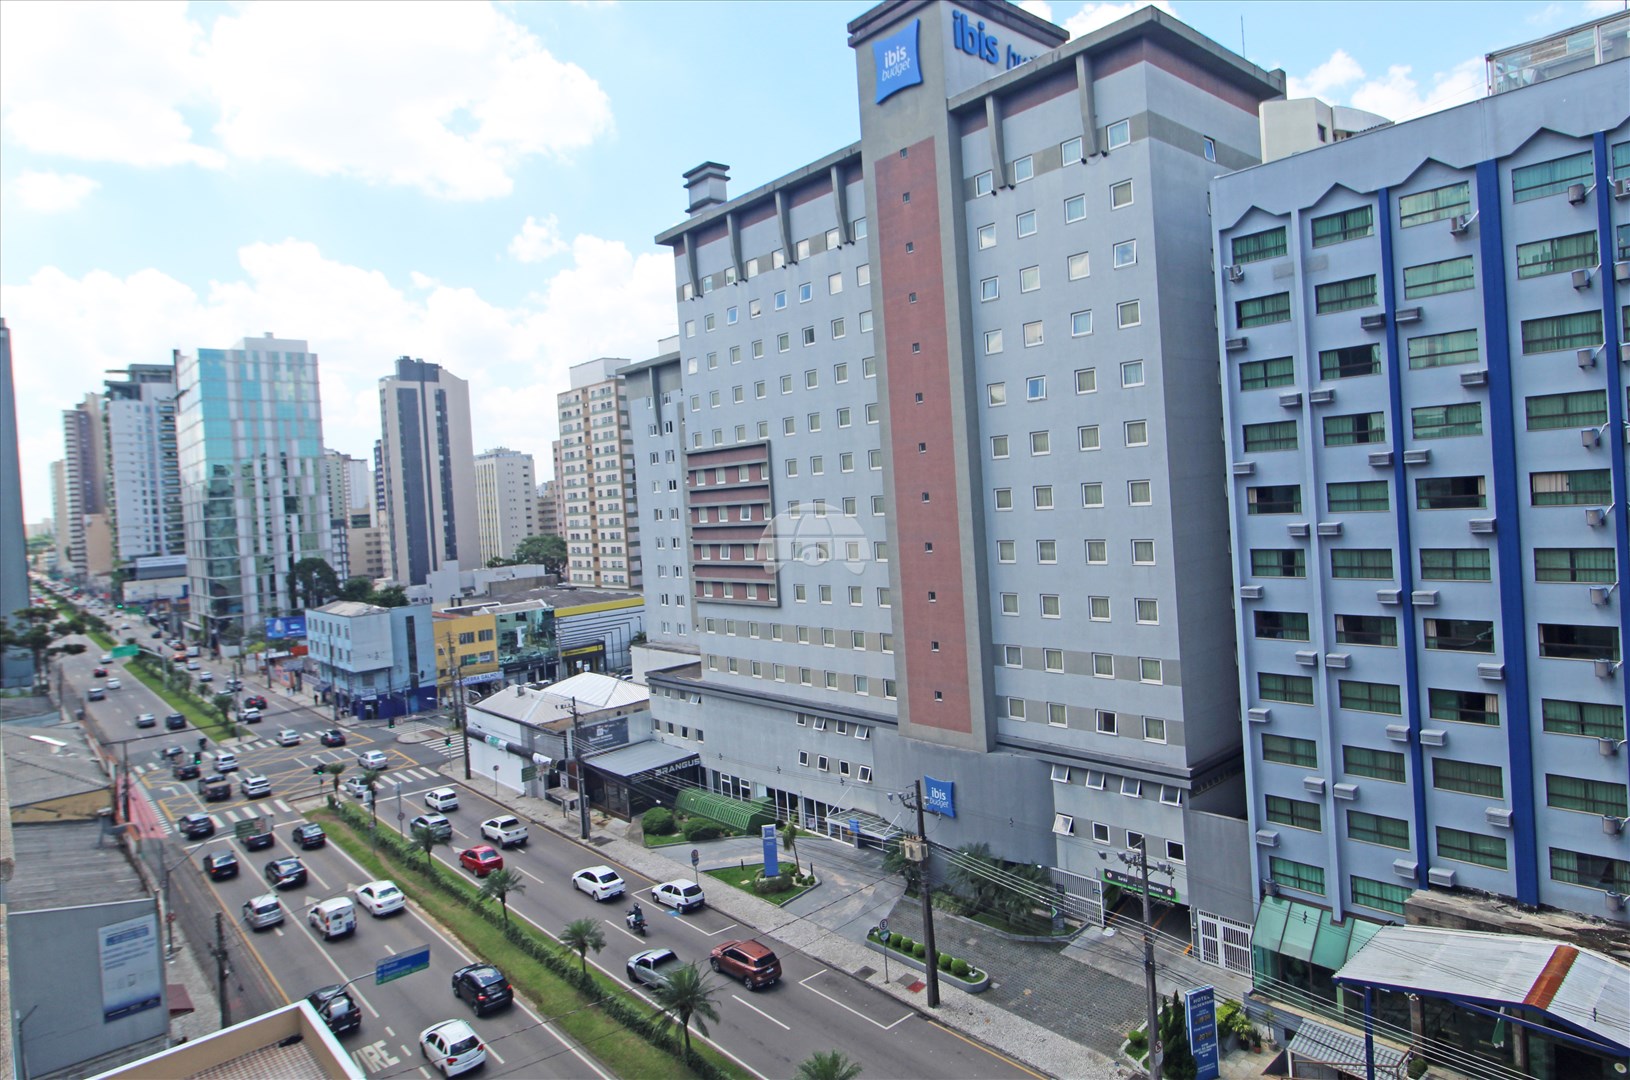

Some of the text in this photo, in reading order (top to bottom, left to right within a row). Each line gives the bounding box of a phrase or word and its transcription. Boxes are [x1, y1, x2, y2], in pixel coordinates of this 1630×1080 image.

[952, 9, 999, 65] ibis
[884, 45, 907, 69] ibis
[881, 57, 911, 82] budget
[930, 798, 949, 809] budget
[931, 787, 947, 801] ibis
[1193, 995, 1211, 1004] HOTEL
